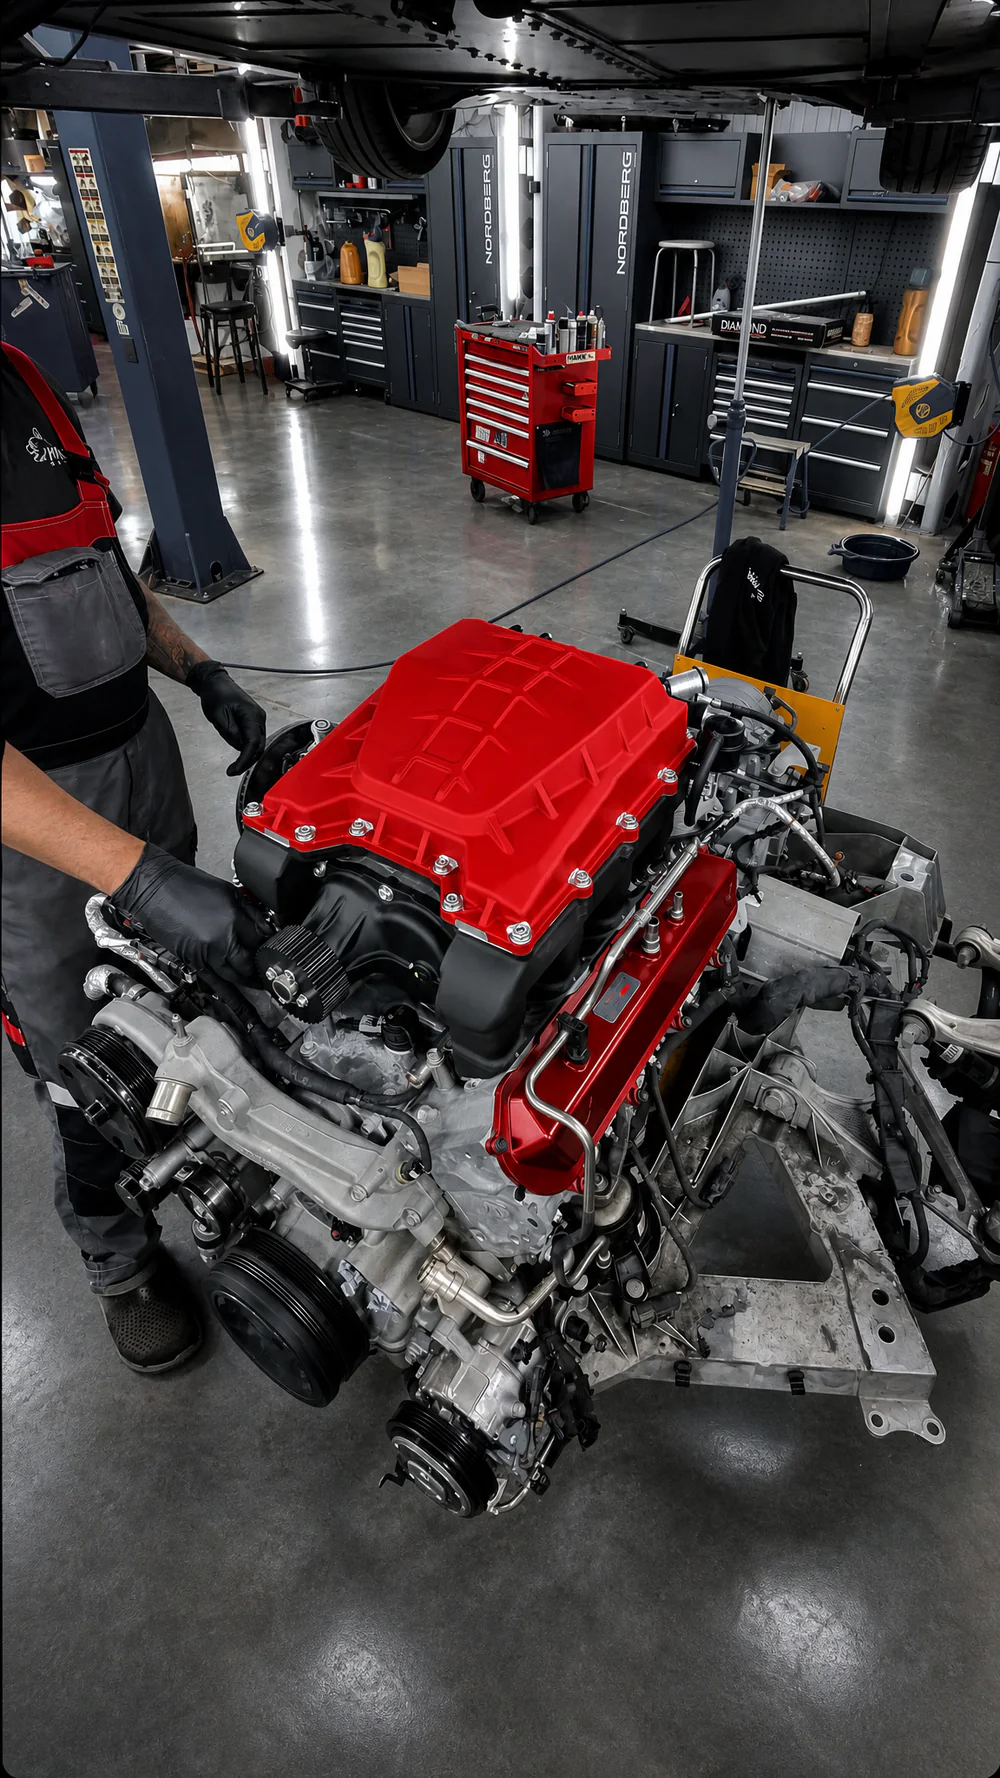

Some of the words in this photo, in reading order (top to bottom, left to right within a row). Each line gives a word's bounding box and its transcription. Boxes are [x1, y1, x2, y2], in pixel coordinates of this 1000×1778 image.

[483, 154, 493, 264] NORDBERG
[616, 151, 633, 275] NORDBERG
[720, 319, 767, 334] DIAMND
